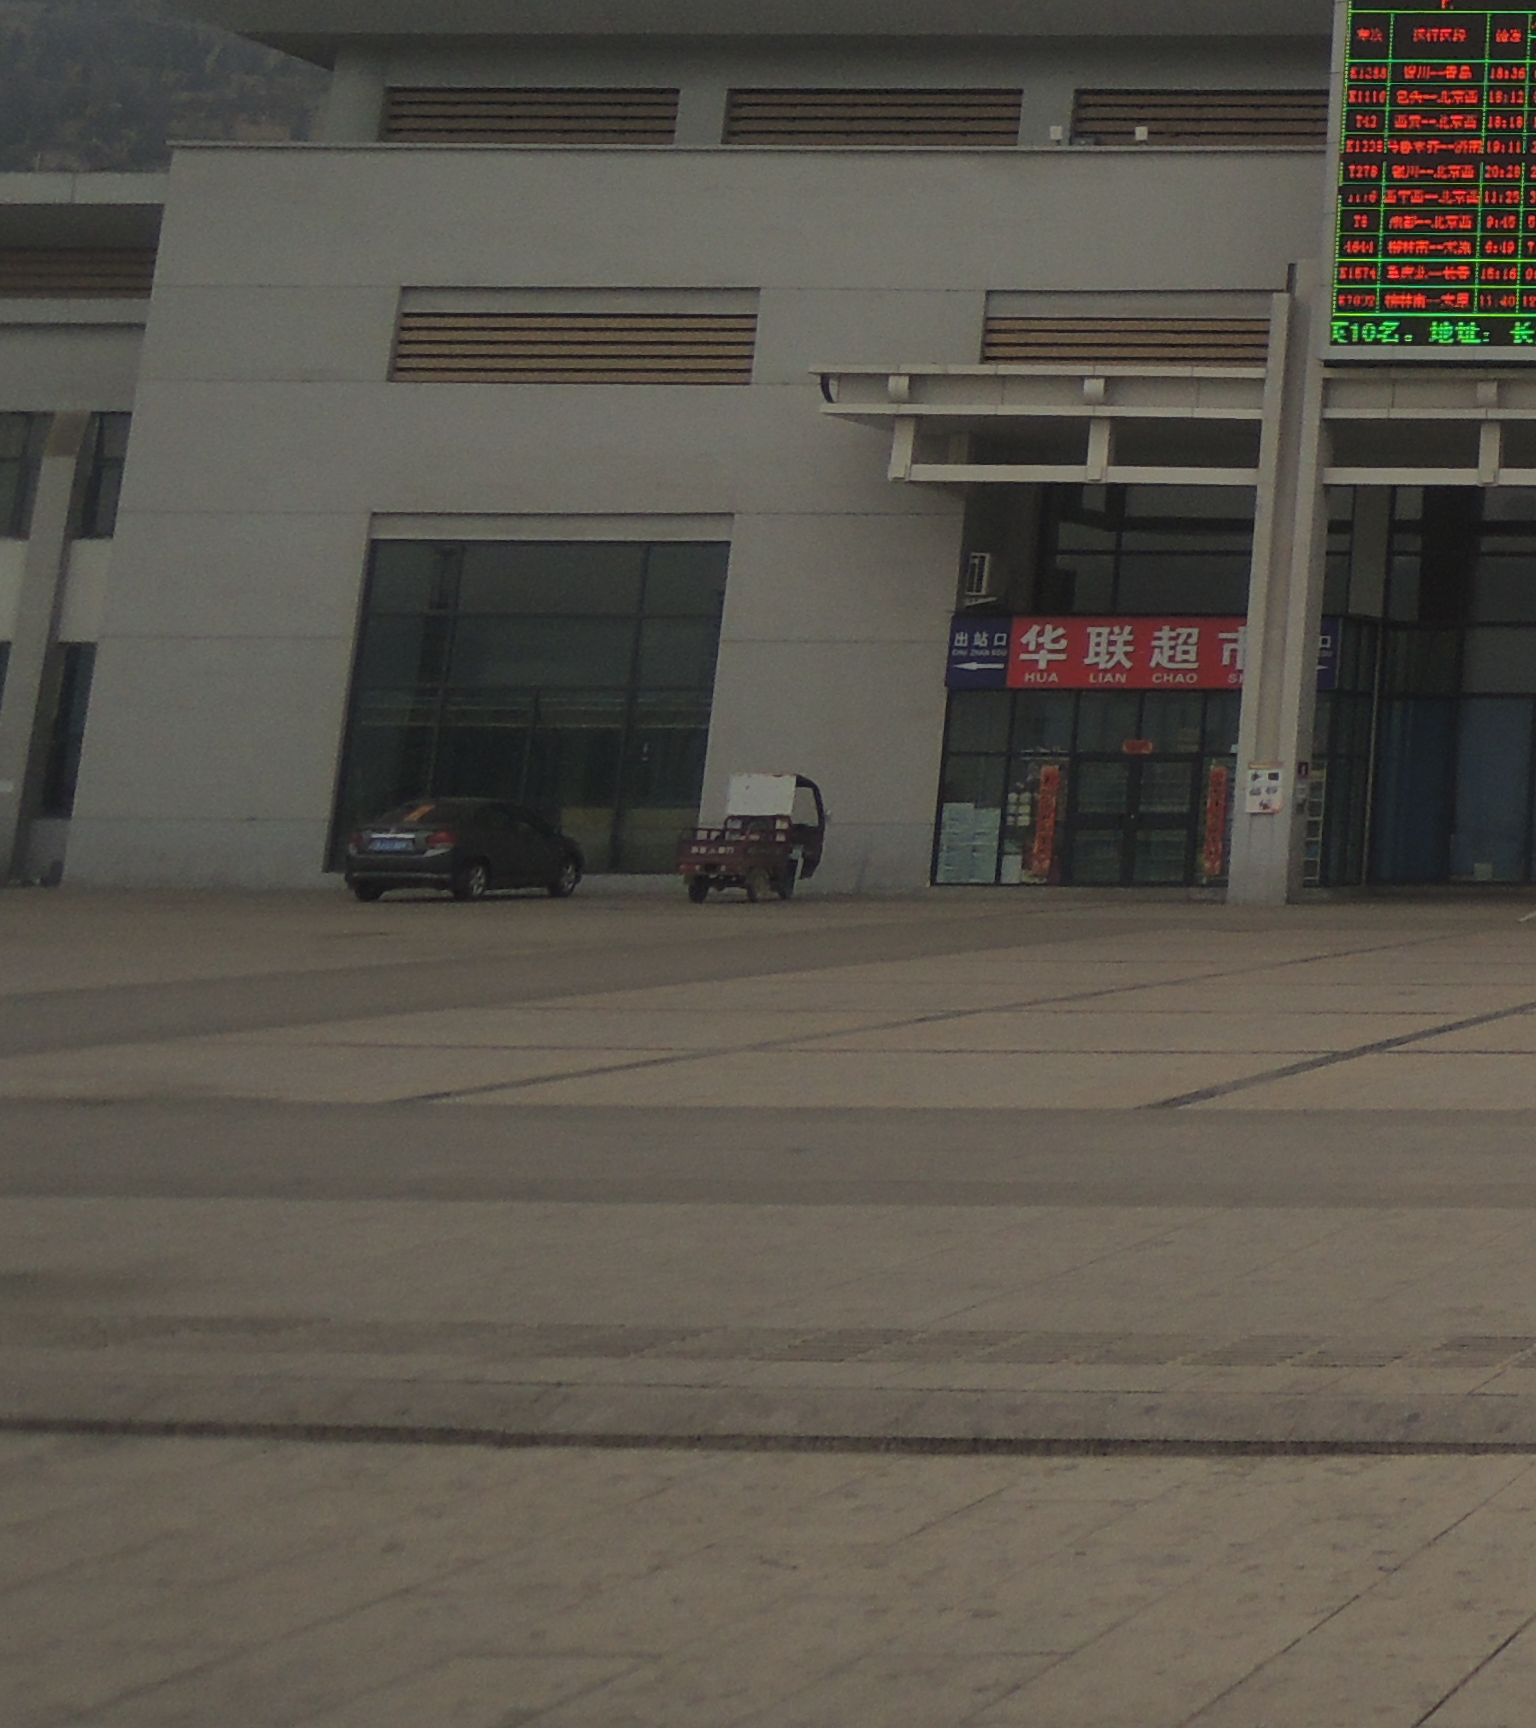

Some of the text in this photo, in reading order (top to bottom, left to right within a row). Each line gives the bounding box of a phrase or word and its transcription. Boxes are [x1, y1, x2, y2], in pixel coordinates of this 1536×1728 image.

[953, 630, 1008, 648] 出站口
[1019, 624, 1247, 670] 华联超市
[1024, 672, 1059, 684] HUA
[1089, 672, 1127, 684] LIAN
[1151, 672, 1198, 684] CHAO
